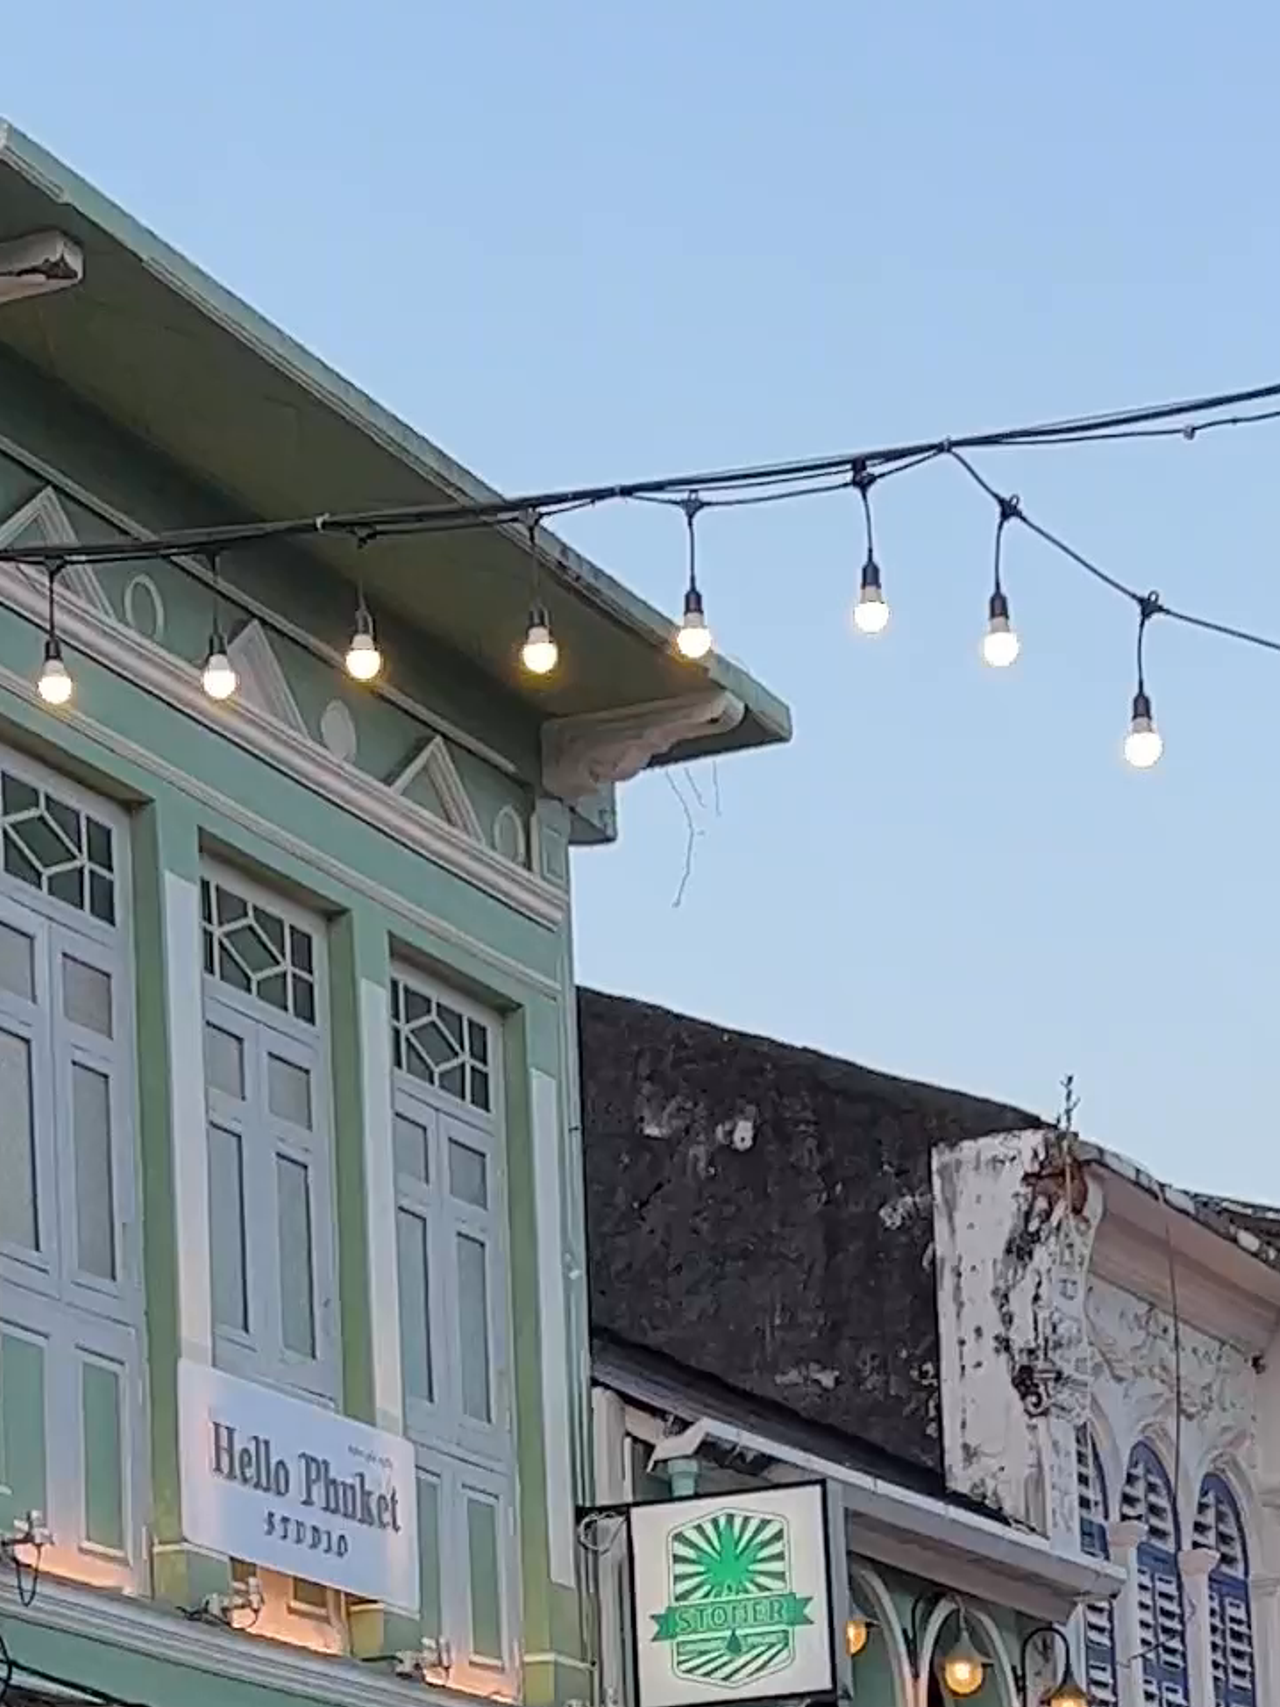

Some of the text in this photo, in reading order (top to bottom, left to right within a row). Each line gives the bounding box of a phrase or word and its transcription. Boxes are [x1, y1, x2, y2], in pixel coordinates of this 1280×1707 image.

[212, 1420, 402, 1534] Hello Phuket
[264, 1510, 349, 1559] STUDIO
[676, 1597, 785, 1633] STONER
